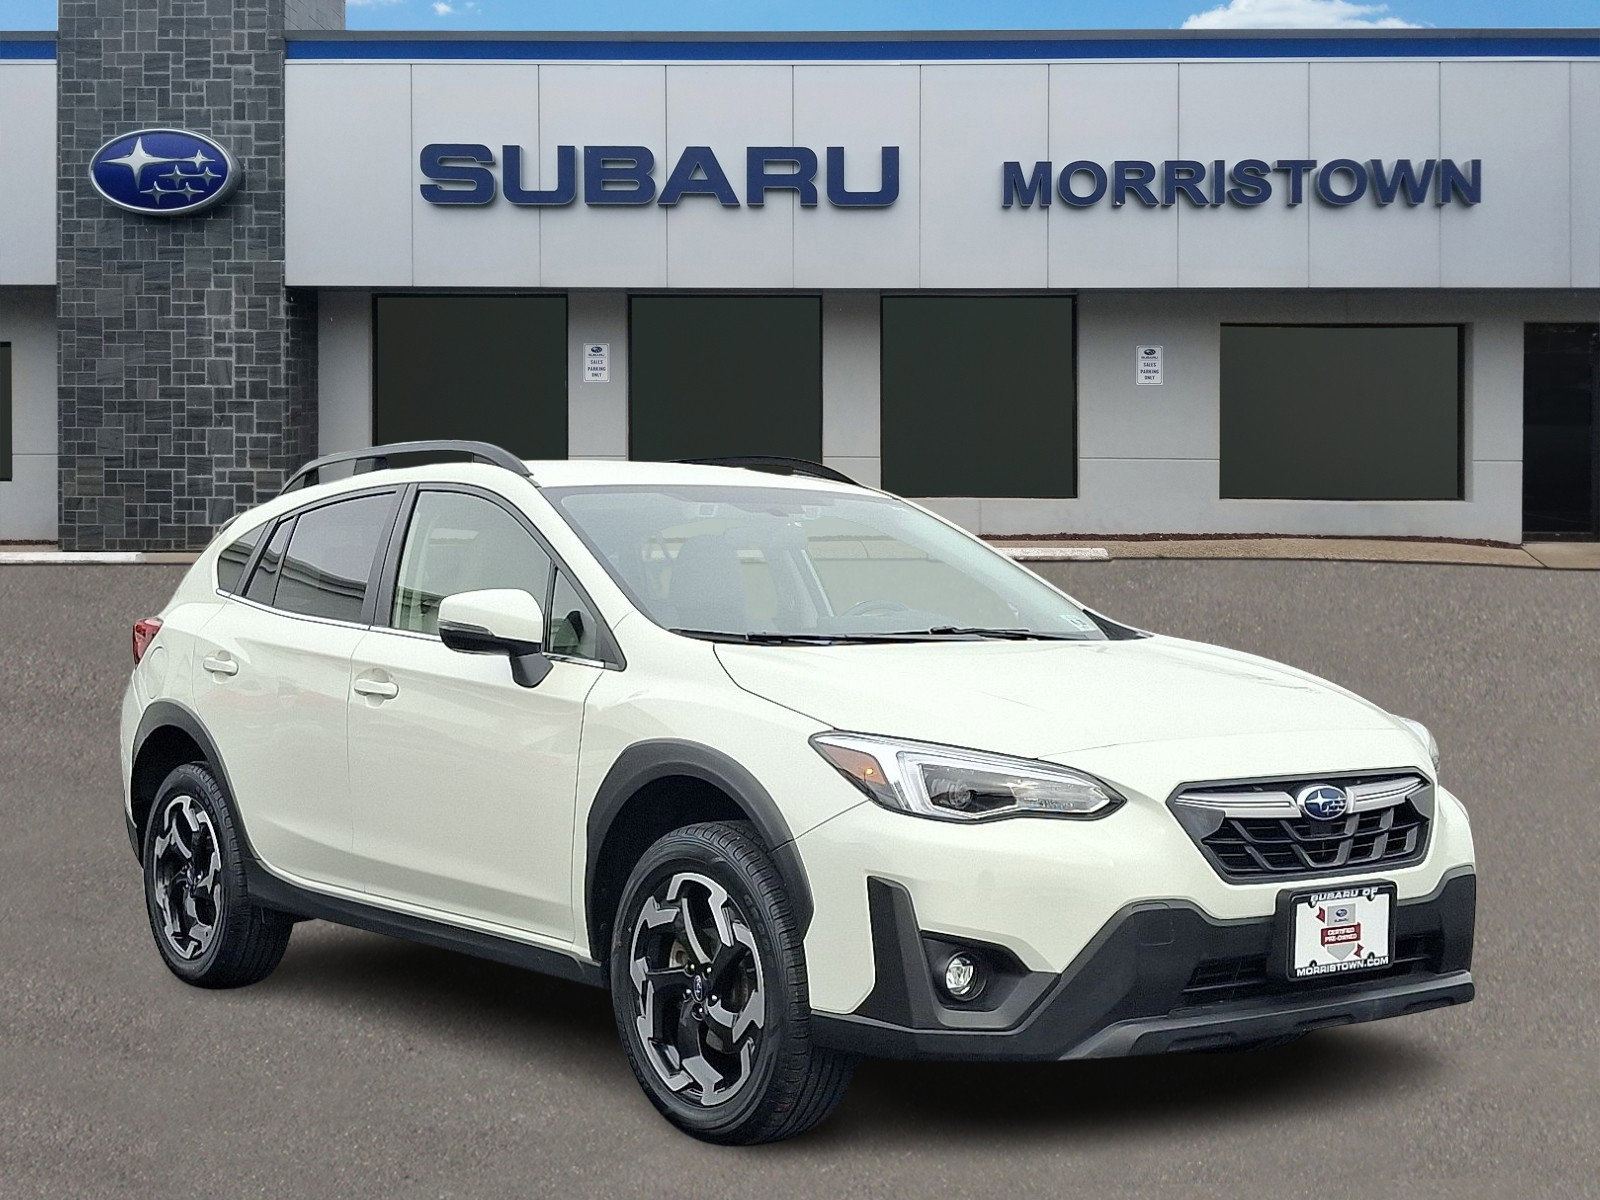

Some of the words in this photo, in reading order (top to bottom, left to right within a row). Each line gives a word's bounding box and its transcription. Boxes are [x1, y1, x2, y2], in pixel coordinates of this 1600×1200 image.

[420, 143, 900, 207] SUBARU
[1001, 158, 1481, 208] MORRISTOWN
[1310, 890, 1359, 901] SUBARU
[1362, 887, 1379, 897] OF
[1296, 956, 1389, 977] MORRISTOWN.COM
